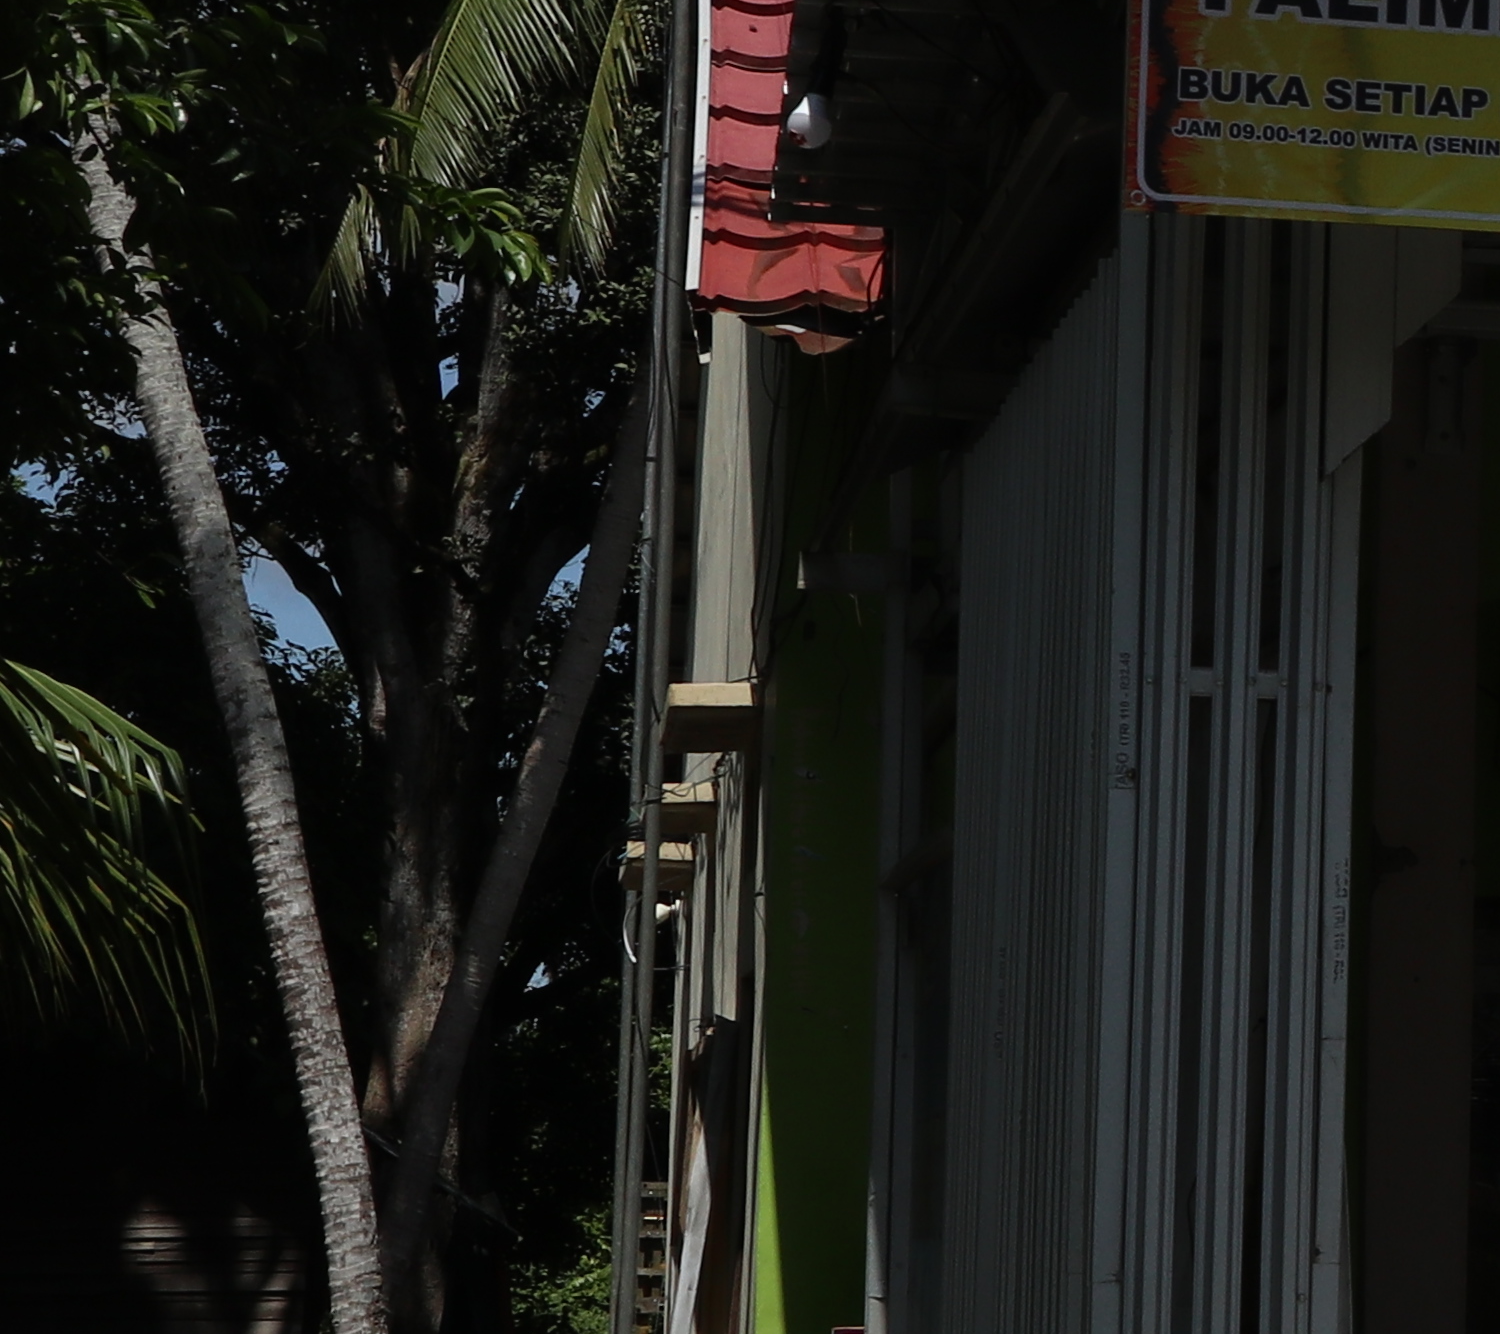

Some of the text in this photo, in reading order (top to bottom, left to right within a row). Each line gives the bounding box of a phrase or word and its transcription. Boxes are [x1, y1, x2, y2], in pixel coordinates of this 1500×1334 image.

[1179, 69, 1309, 107] BUKA
[1325, 78, 1488, 118] SETIAP
[1174, 120, 1220, 137] JAM
[1229, 123, 1355, 147] 09.00-12.00
[1362, 133, 1418, 152] WITA
[1425, 136, 1500, 157] (SENIN
